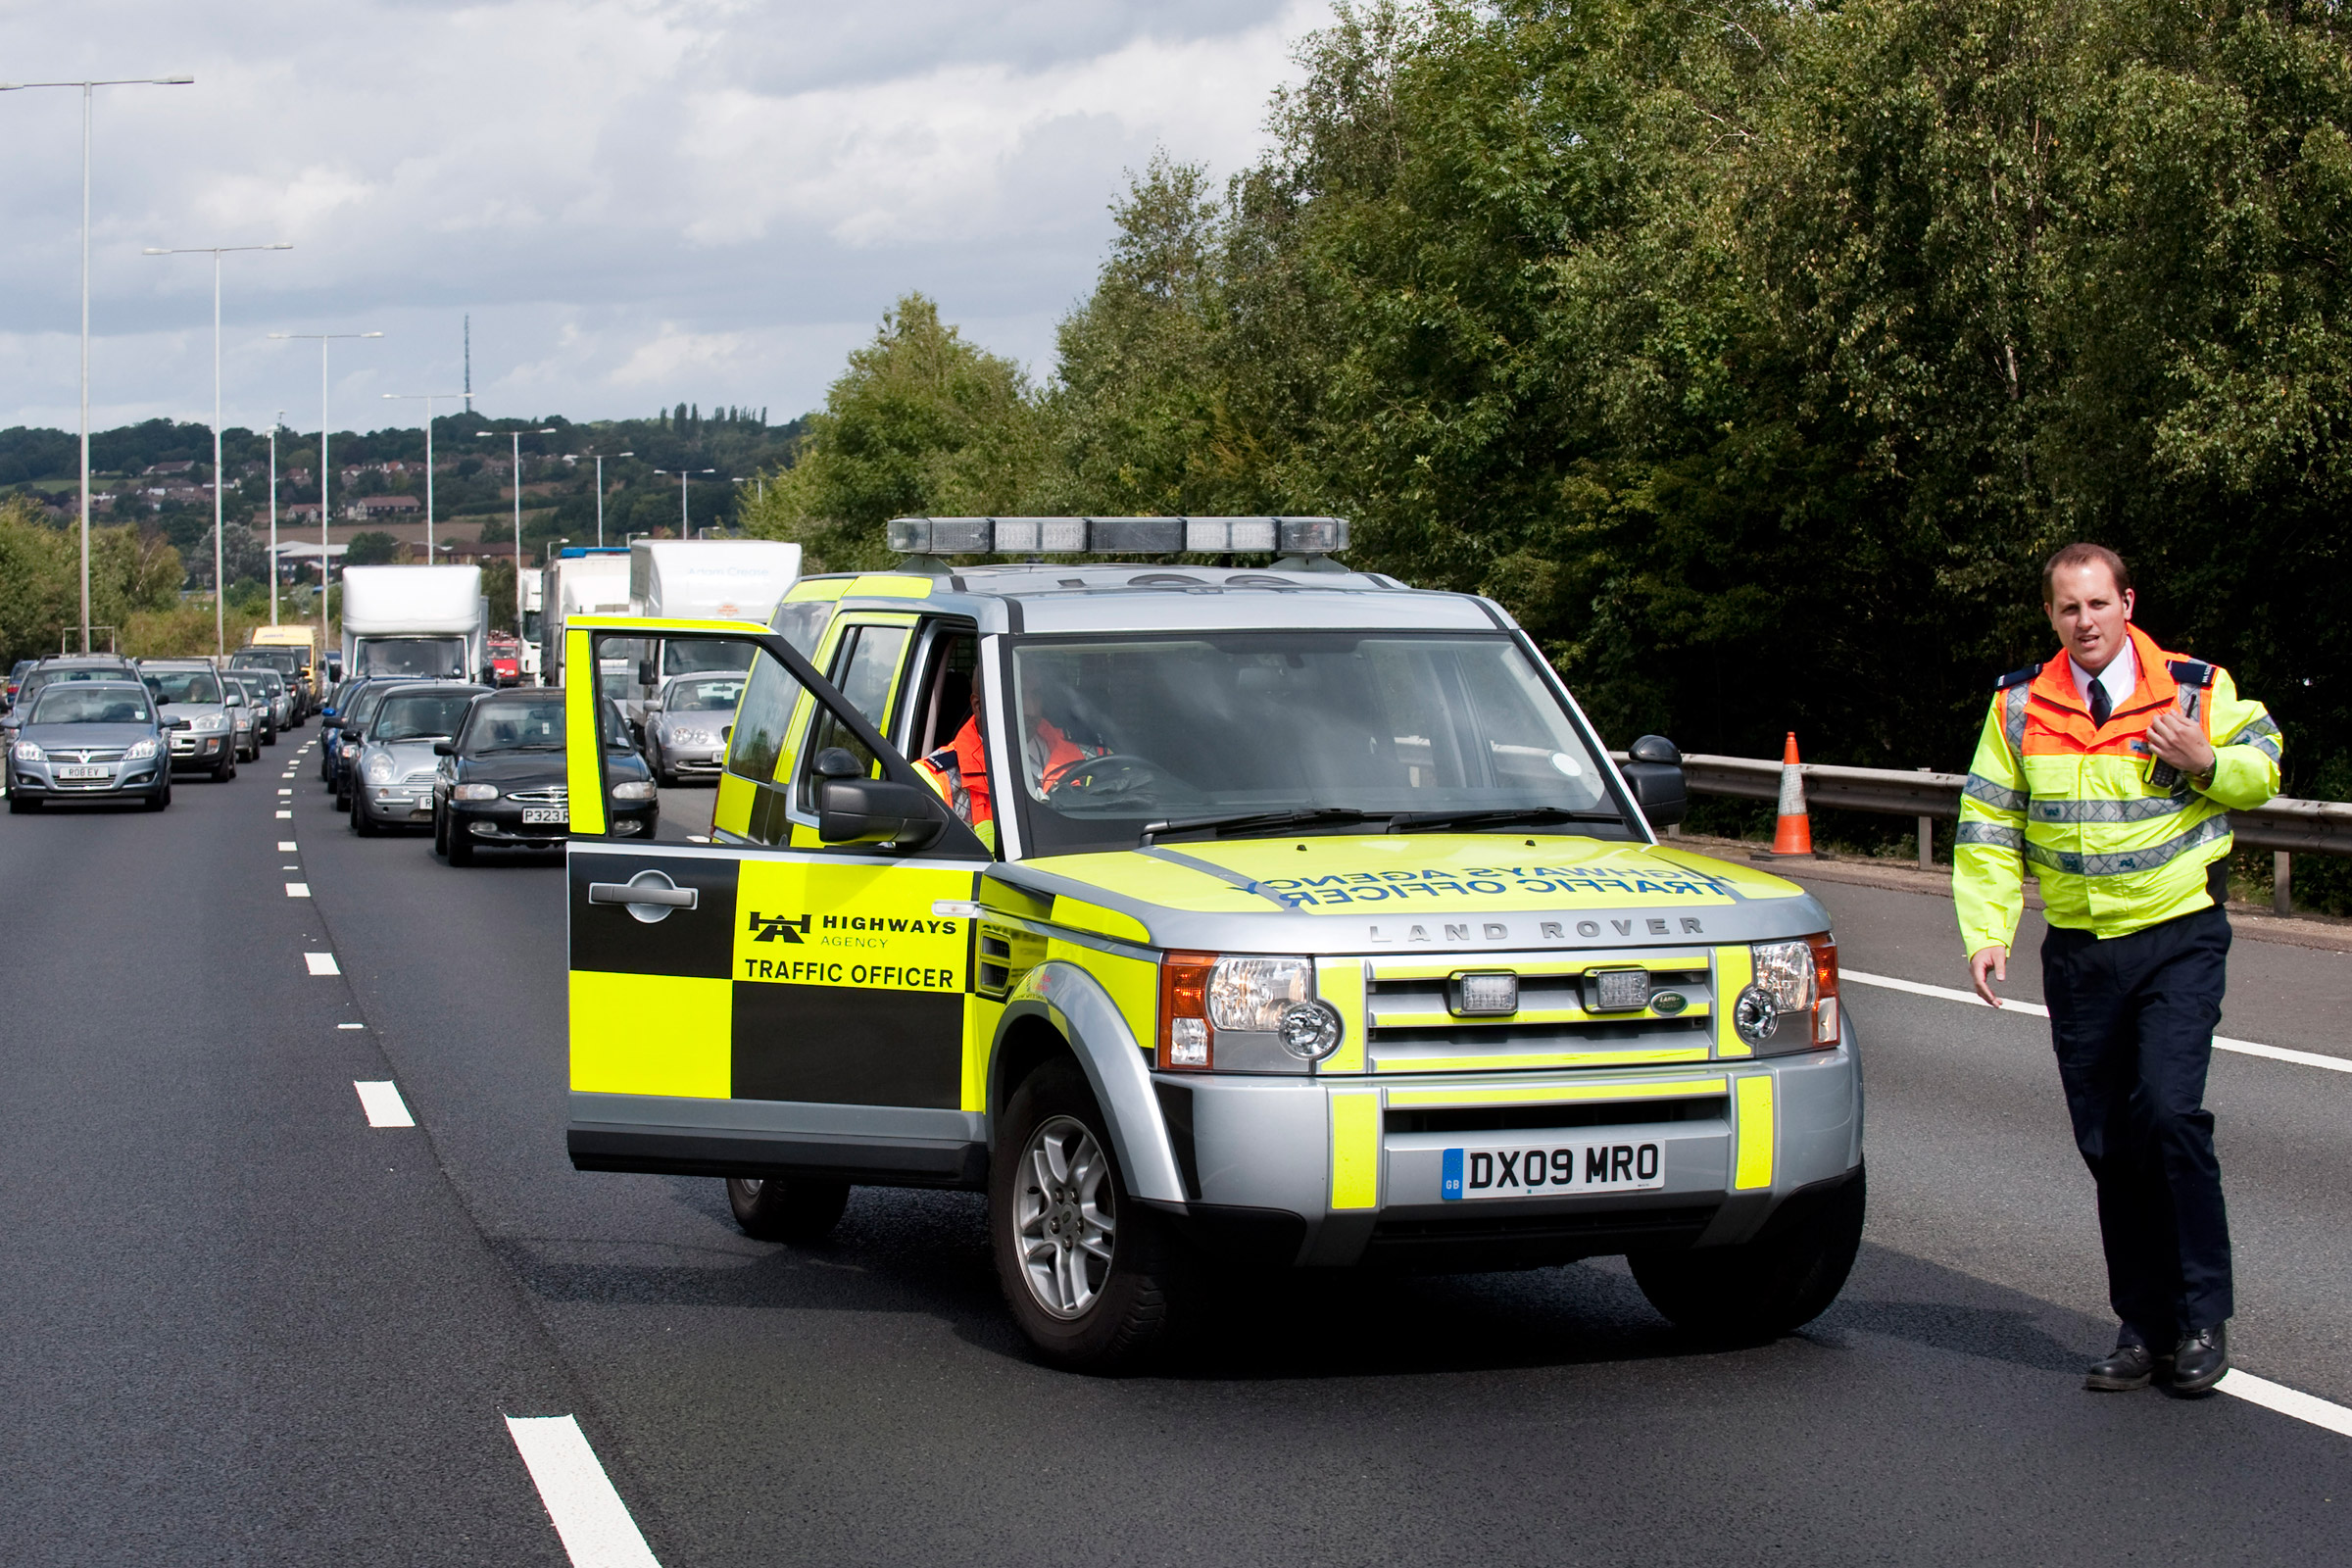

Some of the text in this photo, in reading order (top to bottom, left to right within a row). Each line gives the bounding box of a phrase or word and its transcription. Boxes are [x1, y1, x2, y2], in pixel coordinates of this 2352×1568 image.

[525, 809, 560, 821] P323
[822, 914, 956, 935] HIGHWAYS
[1369, 916, 1704, 943] LAND ROVER
[820, 935, 889, 949] AGENCY
[745, 958, 954, 988] TRAFFIC OFFICER
[1469, 1143, 1658, 1189] DX09 MRO
[1446, 1179, 1460, 1190] GB
